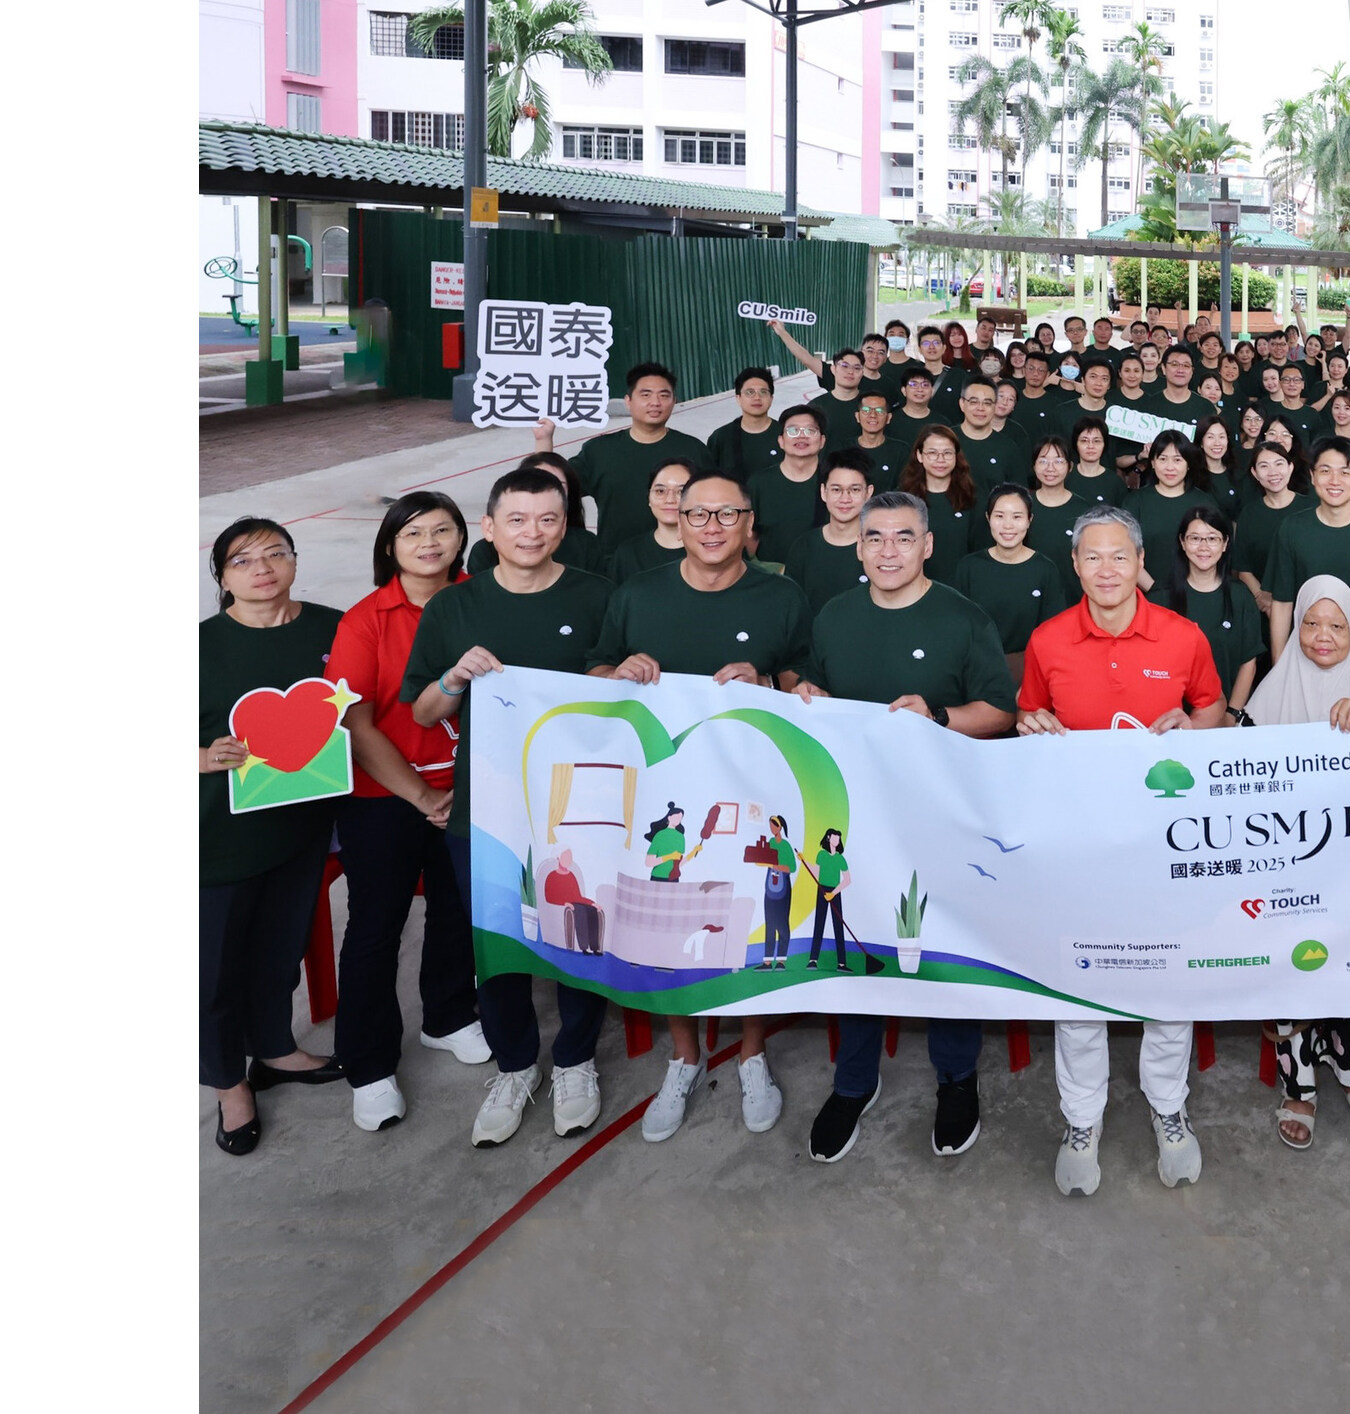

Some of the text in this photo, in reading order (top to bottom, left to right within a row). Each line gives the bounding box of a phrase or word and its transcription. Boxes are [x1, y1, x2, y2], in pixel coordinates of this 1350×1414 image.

[740, 303, 815, 323] CU Smile
[484, 306, 607, 359] 國泰
[480, 371, 603, 423] 送暖
[1107, 407, 1136, 426] CU
[1208, 758, 1278, 779] Cathay
[1209, 779, 1295, 797] 國泰世華銀行
[1166, 814, 1232, 852] CU
[1170, 856, 1286, 879] 國泰送暖 2025
[1269, 893, 1320, 910] TOUCH
[1263, 906, 1328, 919] Community Services
[1073, 942, 1181, 951] Community Supporters:
[1187, 956, 1270, 968] EVERGREEN
